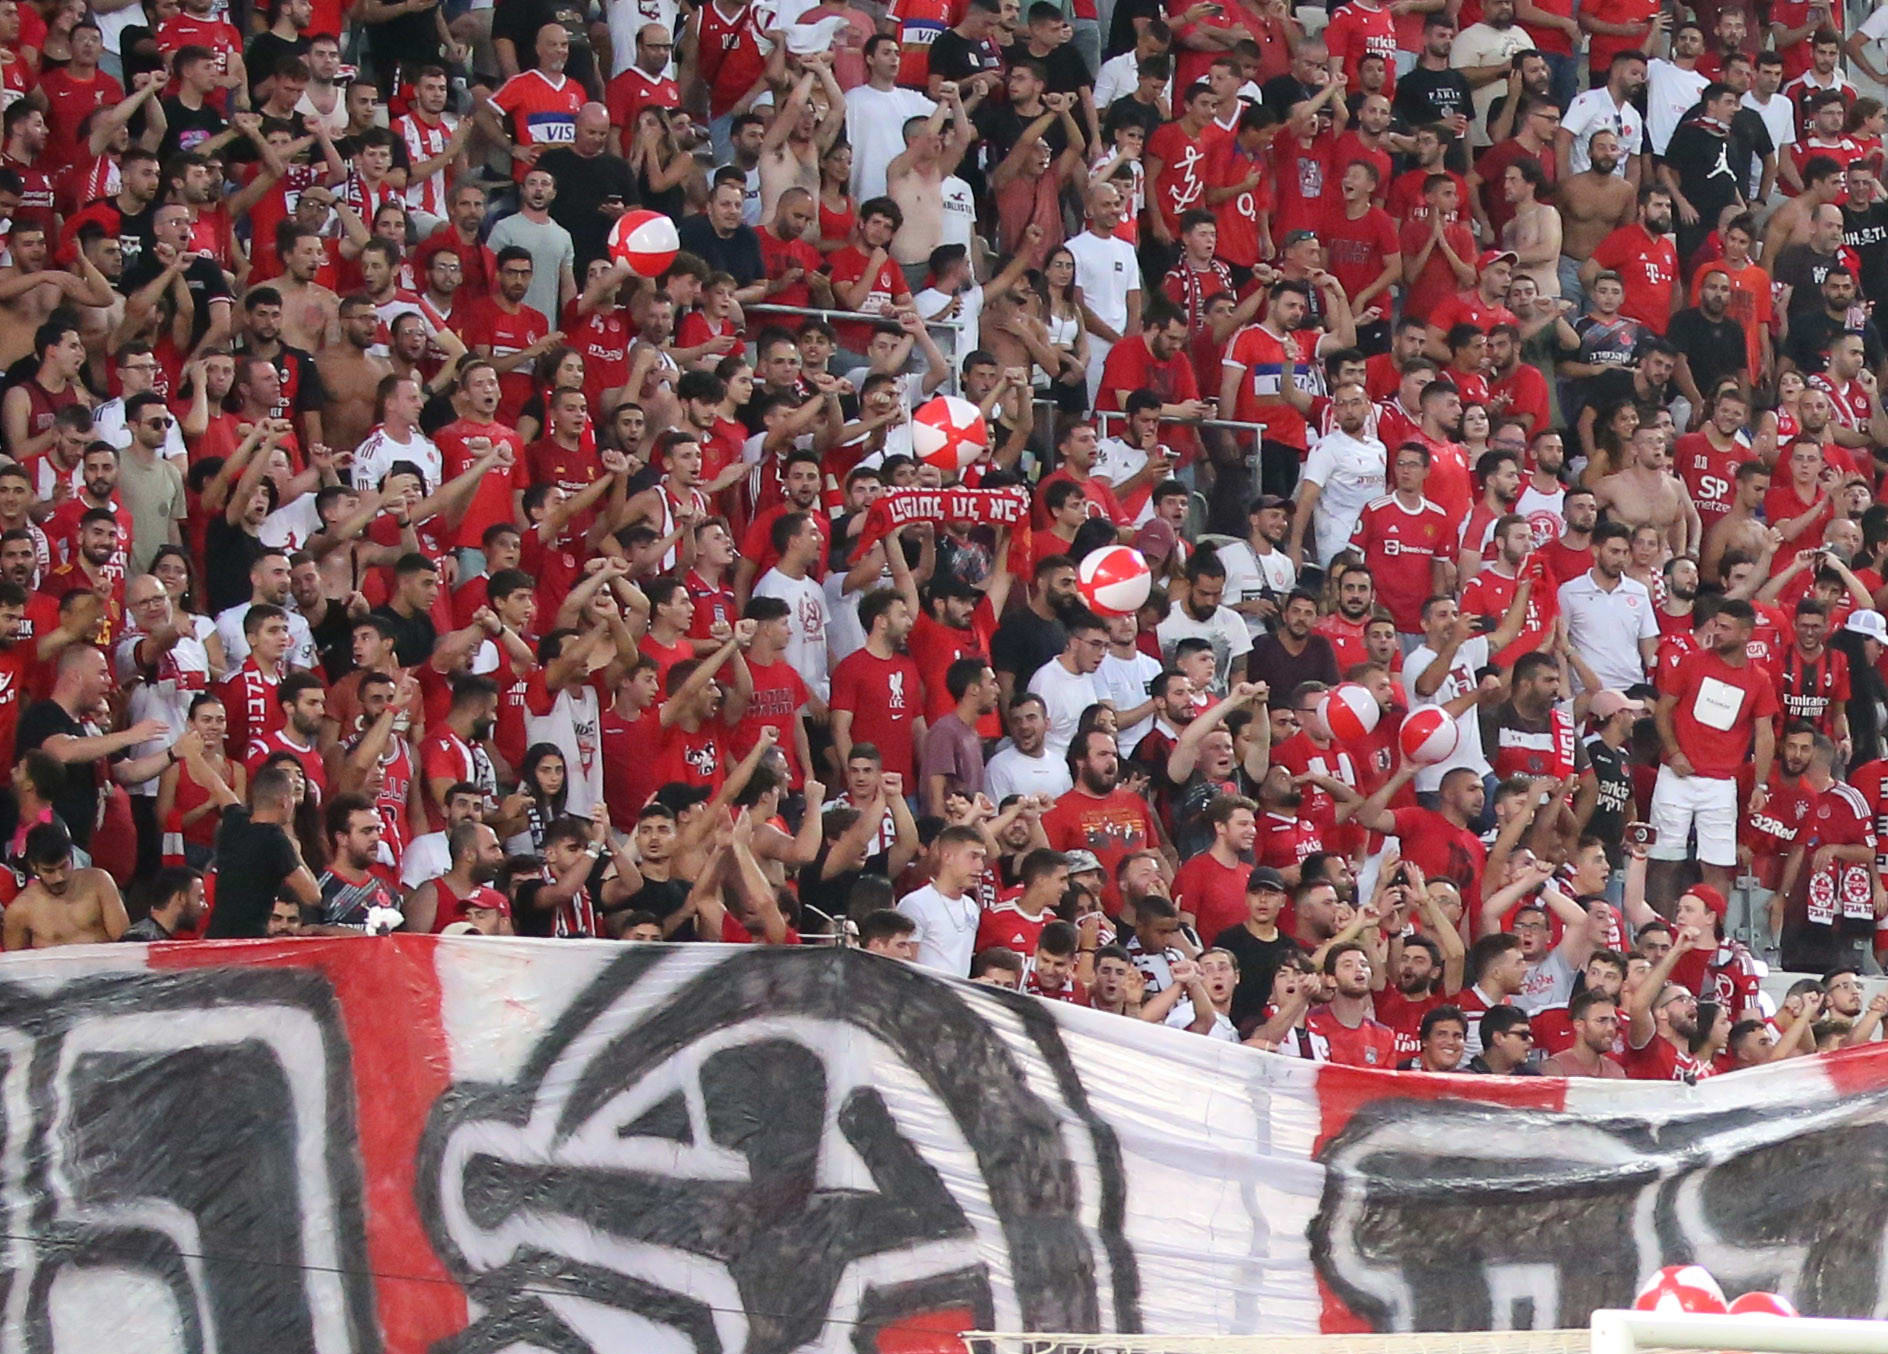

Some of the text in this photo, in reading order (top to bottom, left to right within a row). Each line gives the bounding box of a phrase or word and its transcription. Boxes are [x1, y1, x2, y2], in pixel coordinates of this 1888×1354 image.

[546, 125, 578, 142] VIS
[1698, 475, 1729, 500] SP
[888, 698, 905, 709] LFC
[1784, 693, 1830, 707] Emirates
[1749, 813, 1798, 842] 32Red
